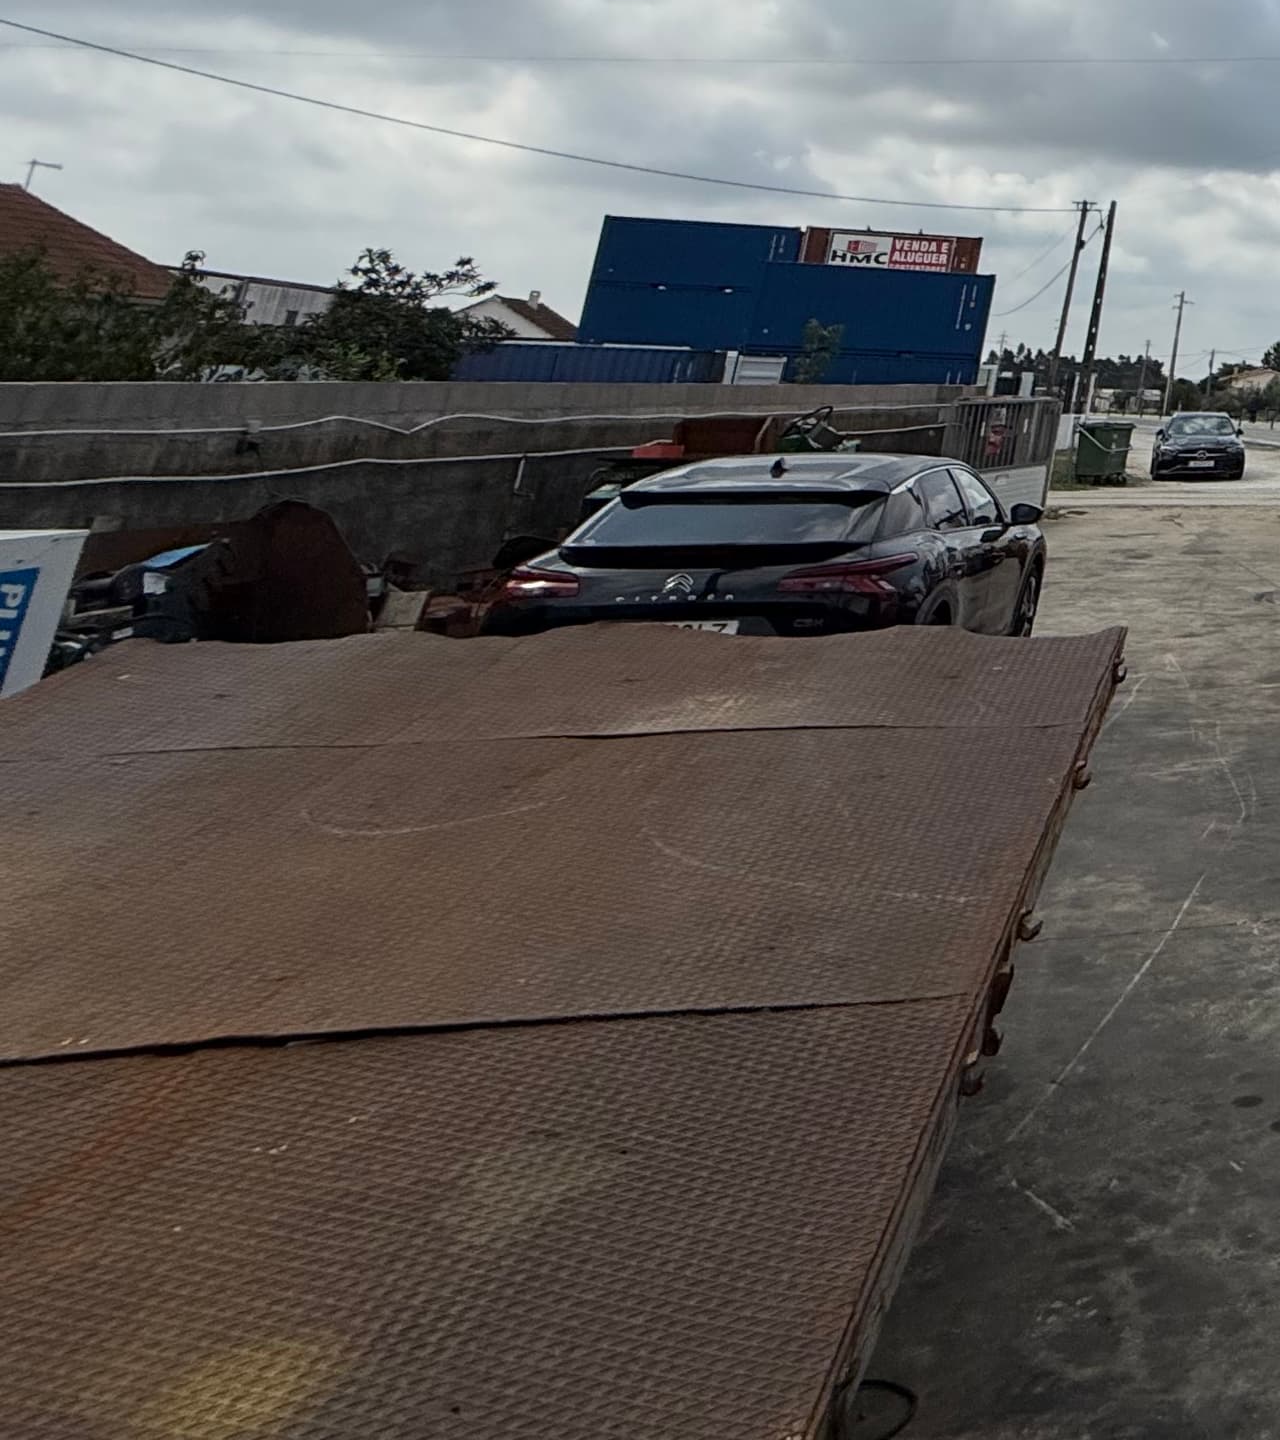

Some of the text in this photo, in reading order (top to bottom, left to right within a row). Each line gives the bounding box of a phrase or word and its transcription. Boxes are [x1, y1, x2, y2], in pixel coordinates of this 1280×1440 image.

[894, 238, 949, 253] VENDA E
[831, 249, 888, 265] HMC
[891, 251, 948, 265] ALUGUER
